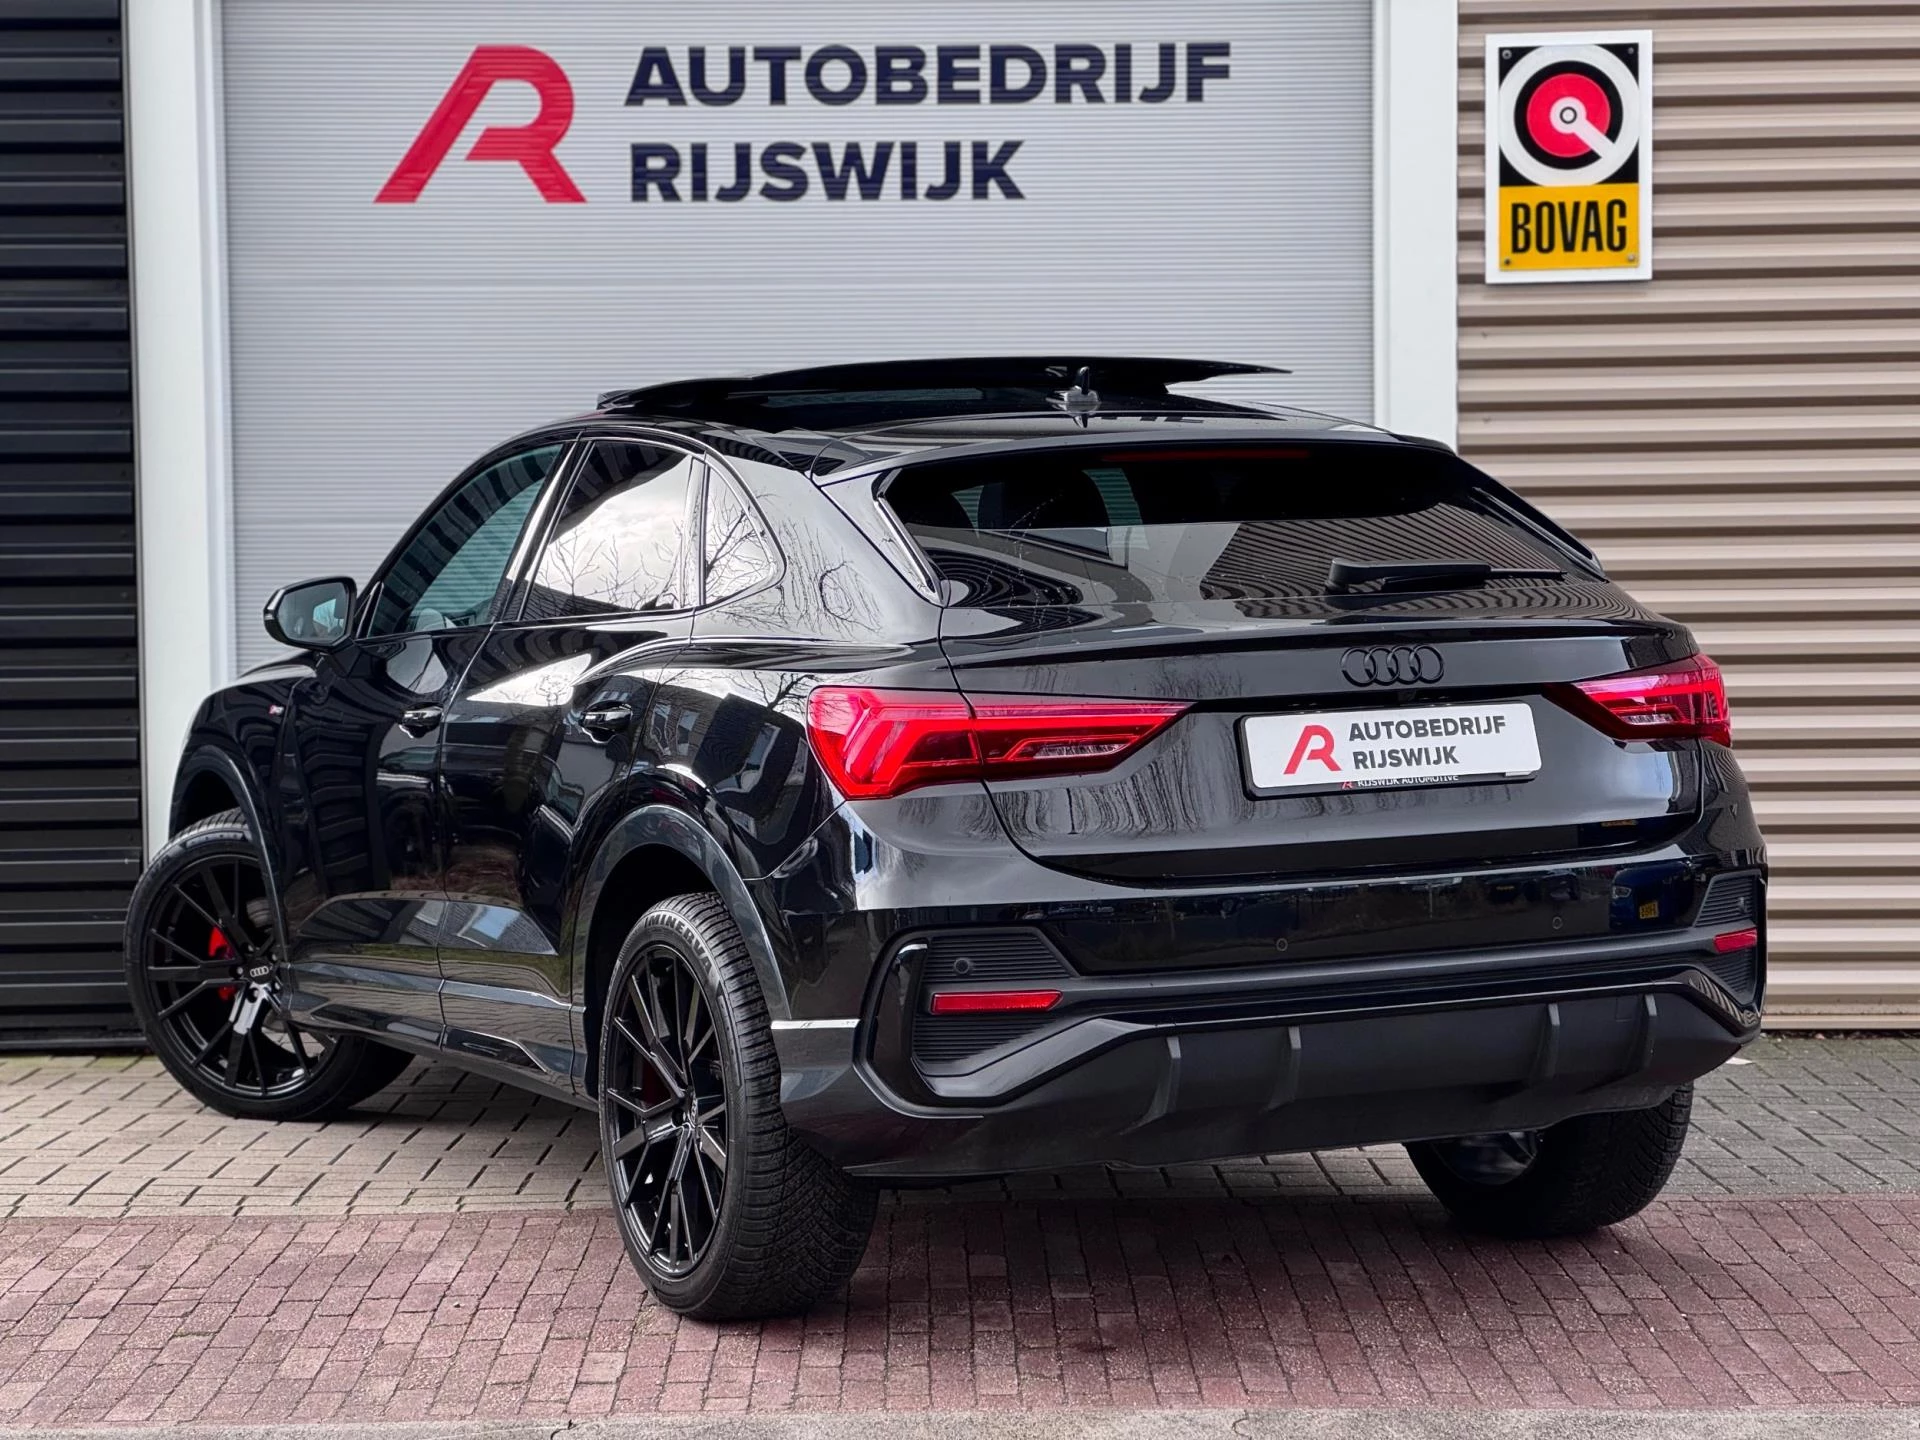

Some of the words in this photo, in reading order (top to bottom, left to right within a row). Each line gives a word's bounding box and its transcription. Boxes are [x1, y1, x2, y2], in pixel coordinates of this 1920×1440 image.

[625, 42, 1231, 106] AUTOBEDRIJF
[631, 140, 1024, 203] RIJSWIJK
[1511, 198, 1627, 254] BOVAG
[1349, 715, 1506, 741] AUTOBEDRIJF
[1353, 745, 1459, 770] RIJSWIJK
